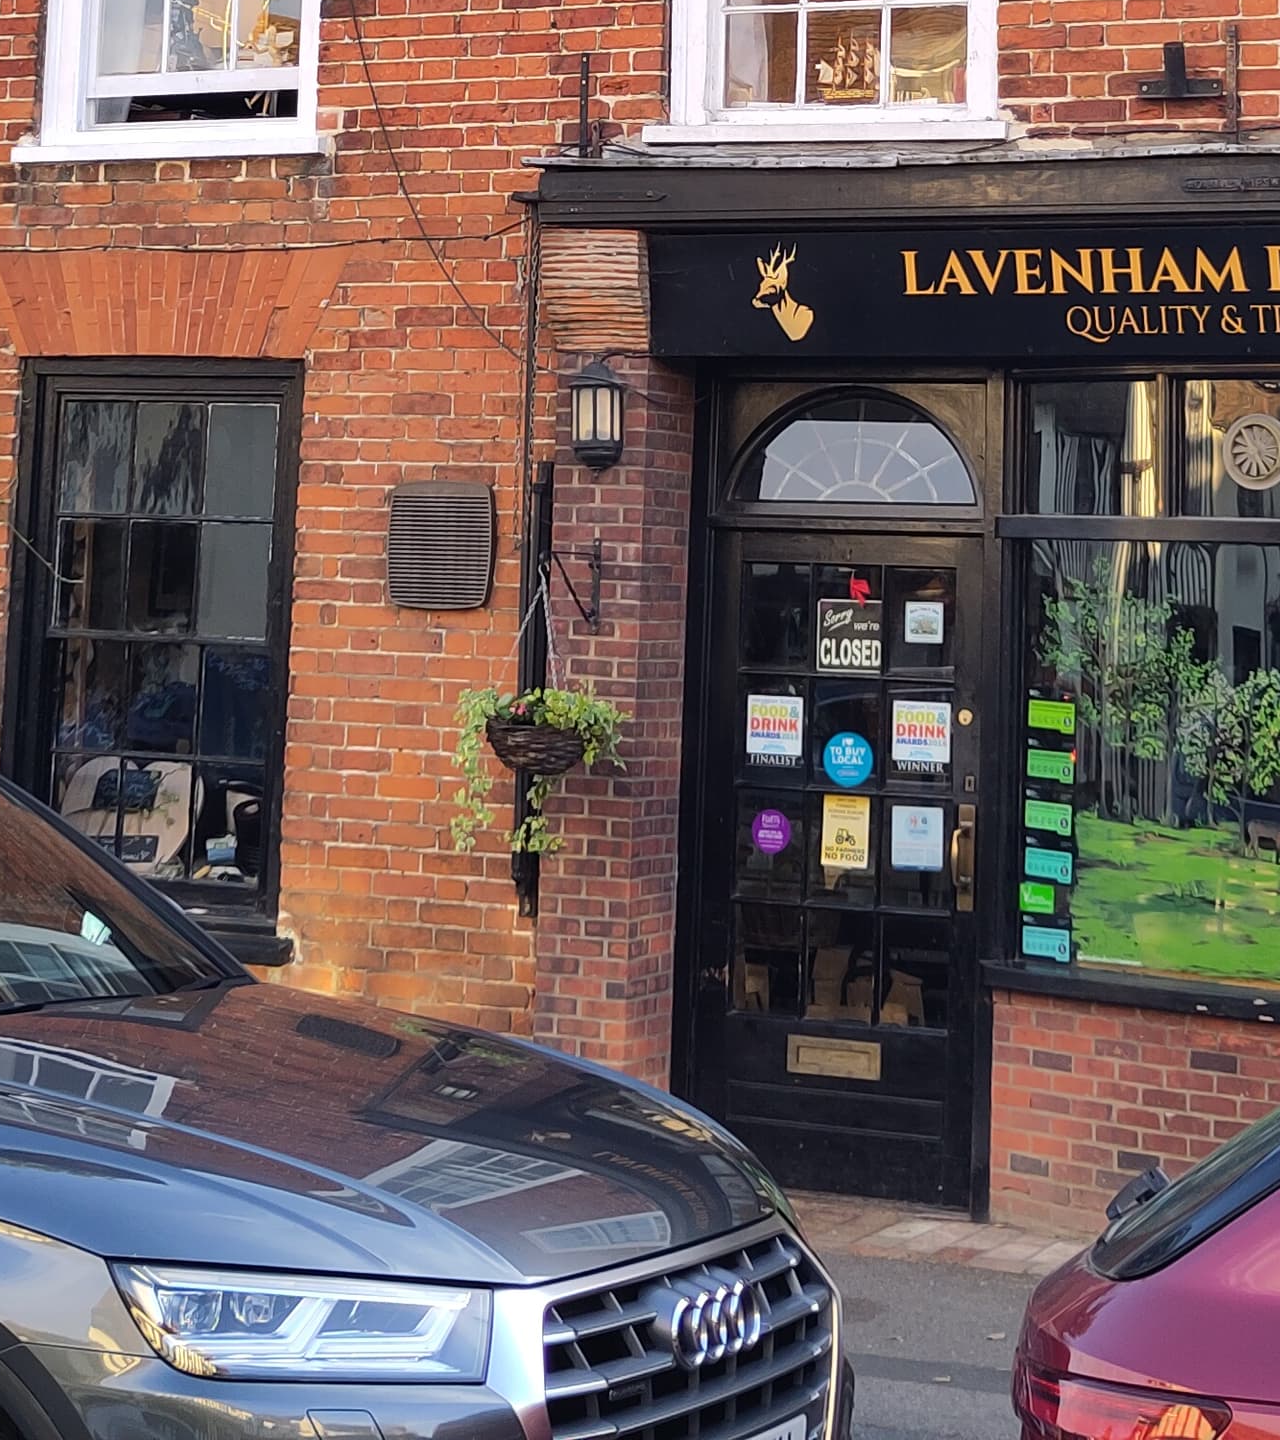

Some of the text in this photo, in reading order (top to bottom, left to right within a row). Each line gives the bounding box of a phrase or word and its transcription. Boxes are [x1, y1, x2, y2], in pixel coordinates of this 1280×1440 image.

[900, 247, 1250, 296] LAVENHAM
[1066, 305, 1211, 343] QUALITY
[1221, 305, 1247, 335] &
[824, 608, 880, 631] Sorry we're
[820, 638, 882, 667] CLOSED
[751, 705, 800, 718] FOOD &
[897, 710, 947, 724] FOOD &
[751, 717, 799, 732] DRINK
[896, 724, 946, 738] DRINK
[830, 746, 866, 756] TO BUY
[750, 754, 797, 766] FINALIST
[831, 755, 864, 765] LOCAL
[897, 760, 944, 773] WINNER
[825, 852, 865, 862] NO FOOD
